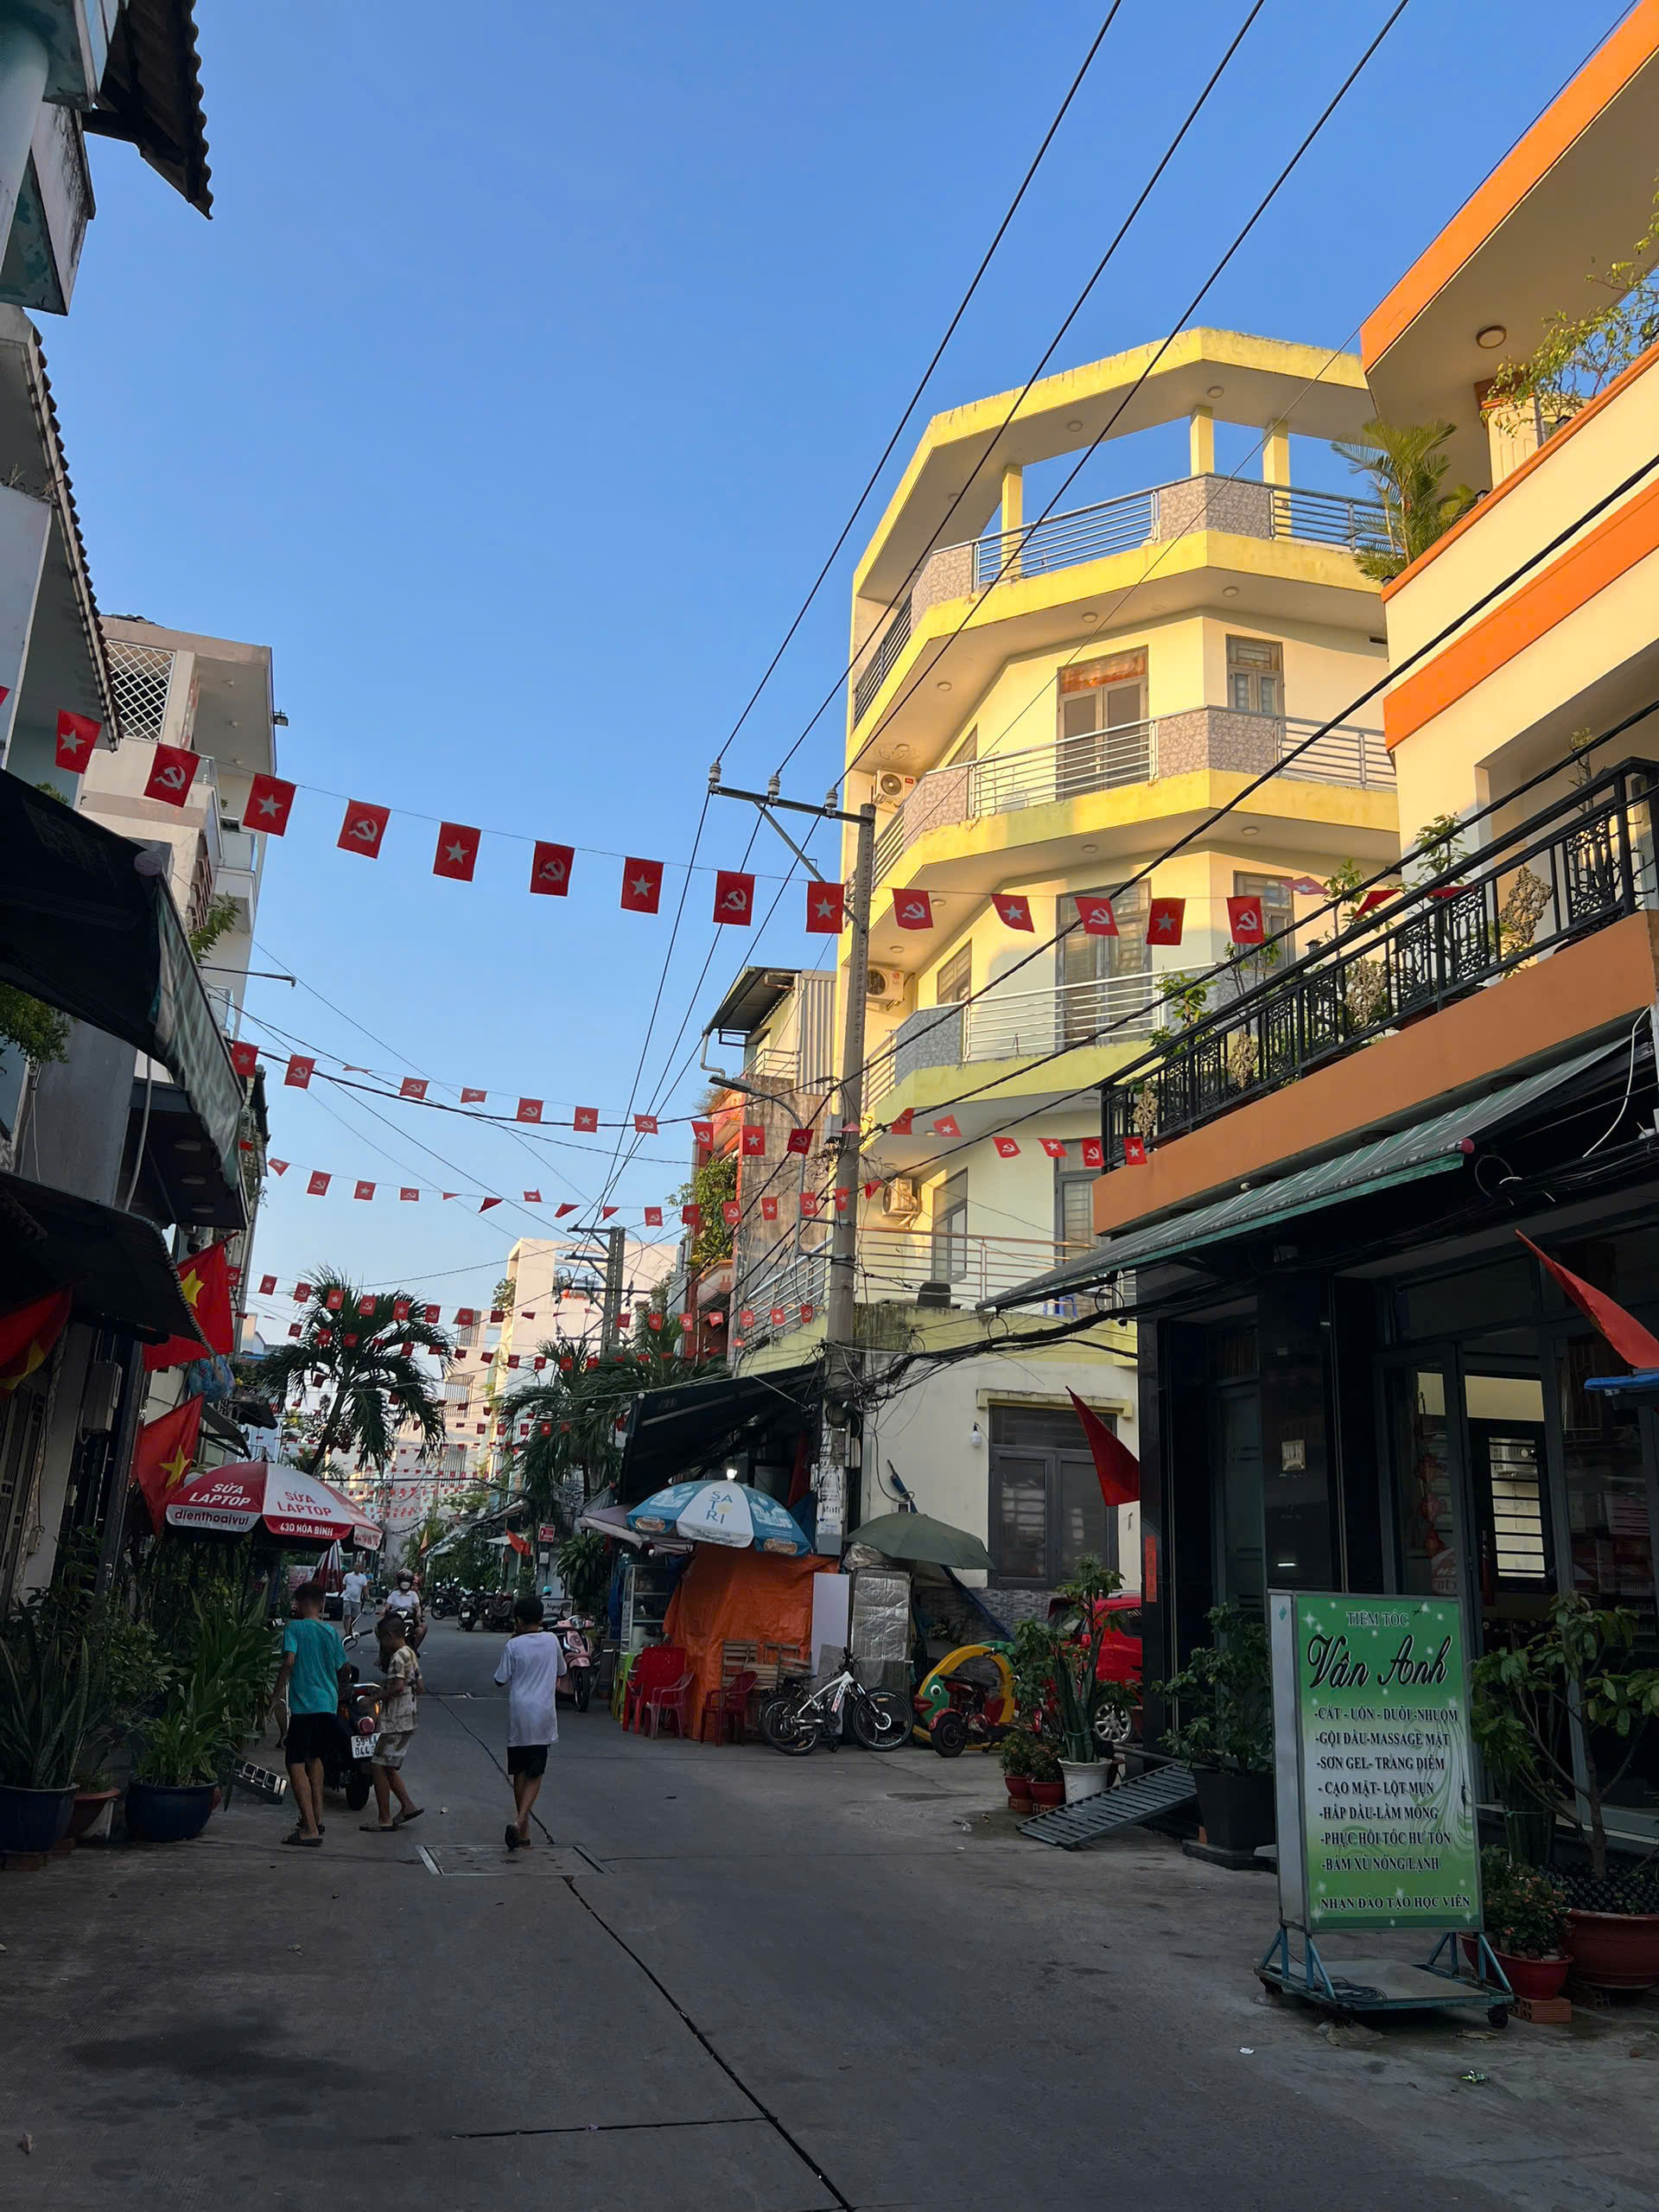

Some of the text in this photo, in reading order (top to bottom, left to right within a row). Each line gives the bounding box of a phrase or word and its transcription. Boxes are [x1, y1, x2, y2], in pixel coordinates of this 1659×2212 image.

[188, 1492, 251, 1507] LAPTOP
[276, 1501, 332, 1516] LAPTOP
[175, 1510, 250, 1525] dienthoaivui
[1346, 1609, 1409, 1628] TIỆM TÓC
[1308, 1634, 1452, 1688] Vân Anh
[1325, 1782, 1349, 1797] CẠO
[1408, 1782, 1434, 1797] MỤN
[1386, 1897, 1411, 1910] TẠO
[1414, 1897, 1440, 1910] HỌC
[1442, 1894, 1471, 1908] VIÊN
